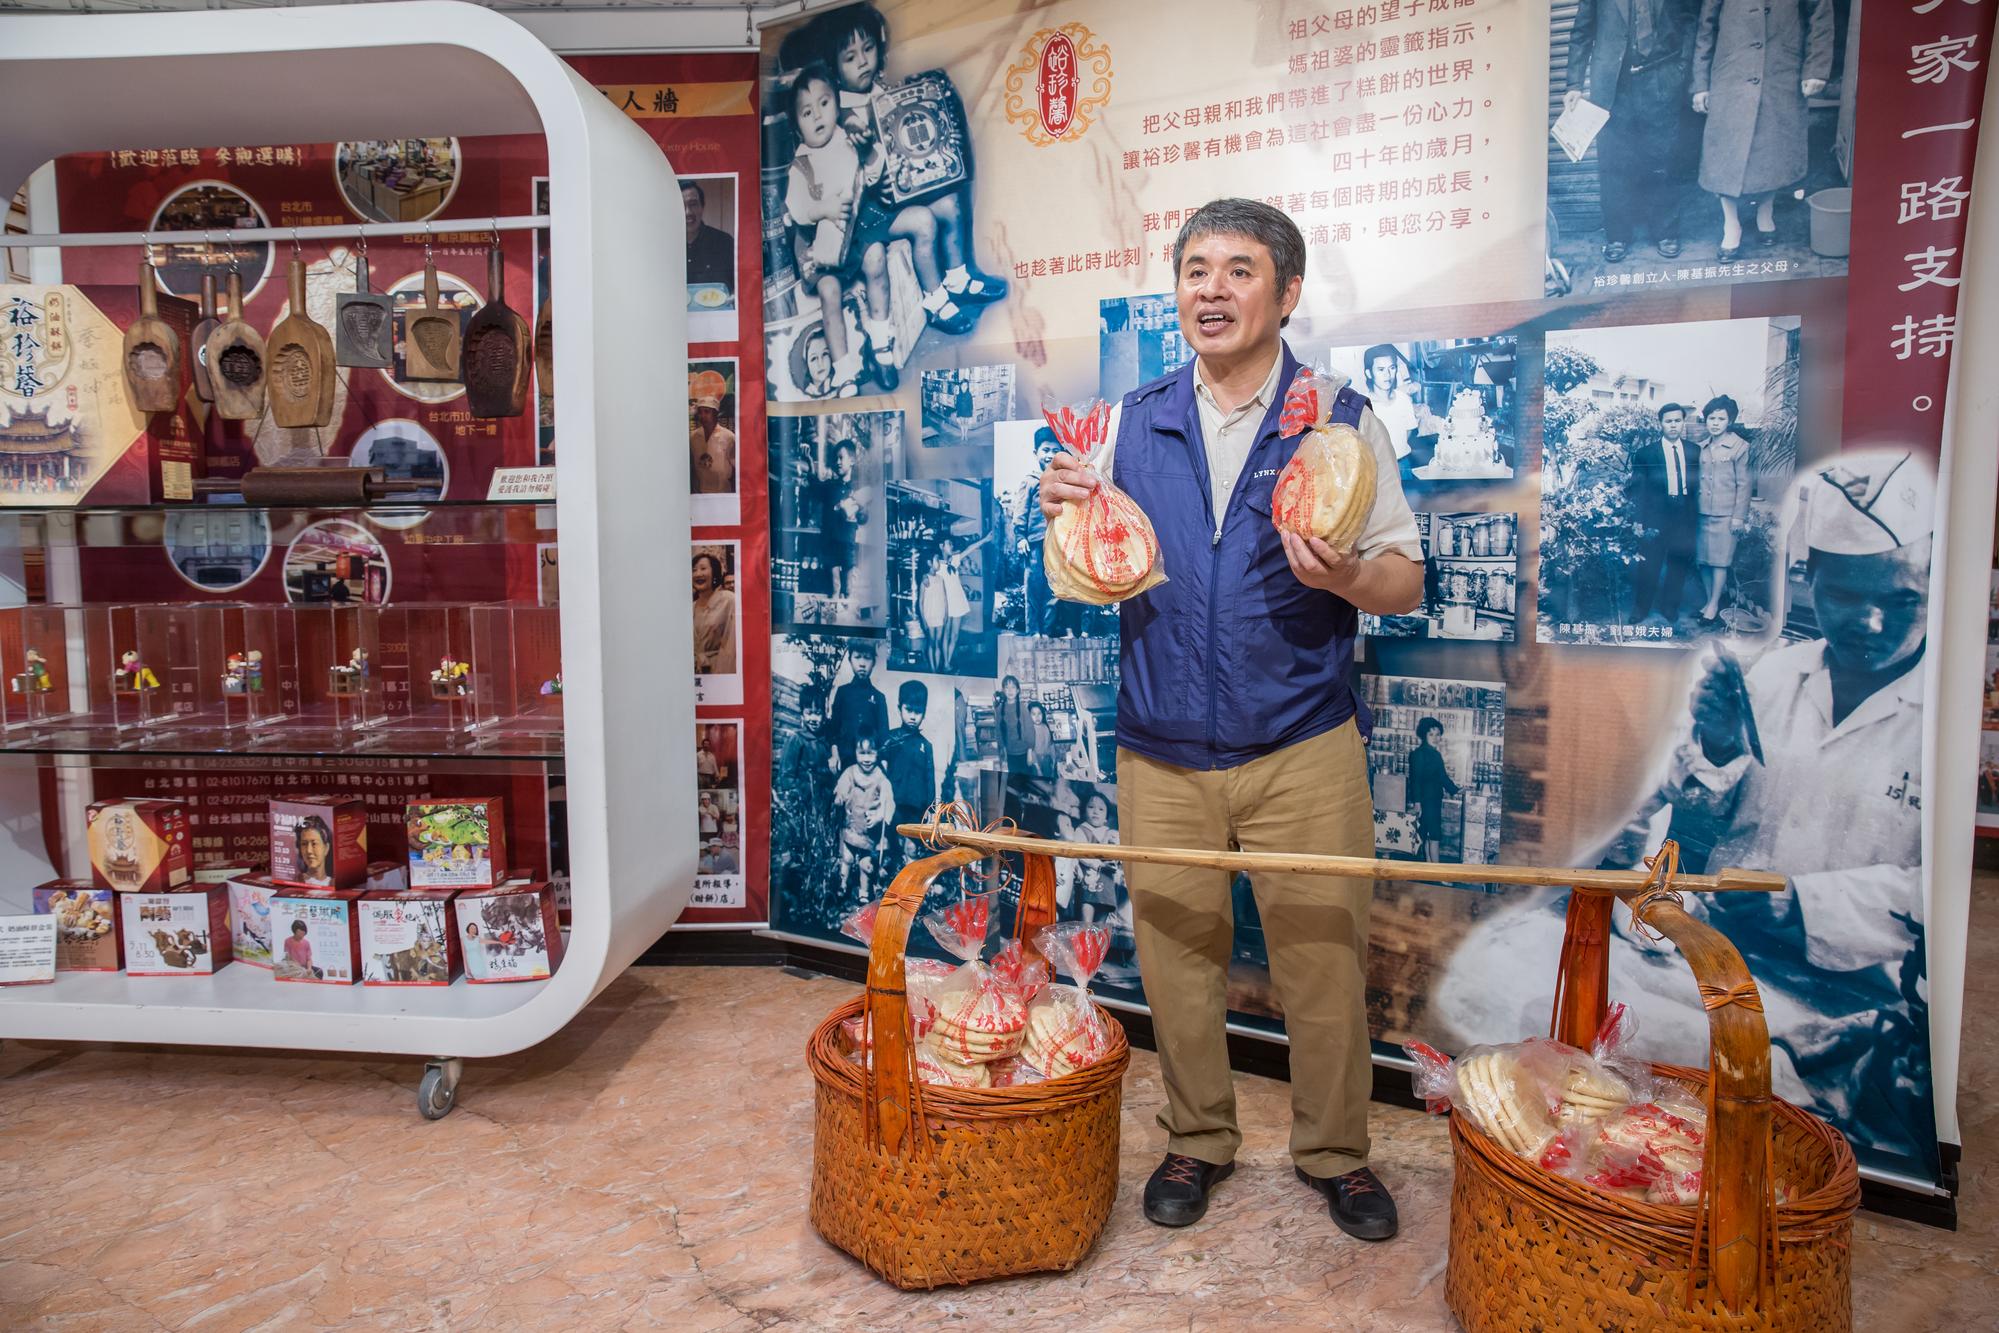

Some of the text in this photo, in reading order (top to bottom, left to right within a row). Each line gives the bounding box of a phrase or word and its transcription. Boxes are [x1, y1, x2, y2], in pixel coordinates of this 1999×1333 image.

[1331, 132, 1493, 174] 四十年的歲月，
[1889, 0, 1981, 413] 家一路支持。
[8, 297, 45, 397] 裕珍馨
[1253, 469, 1276, 479] LYNX
